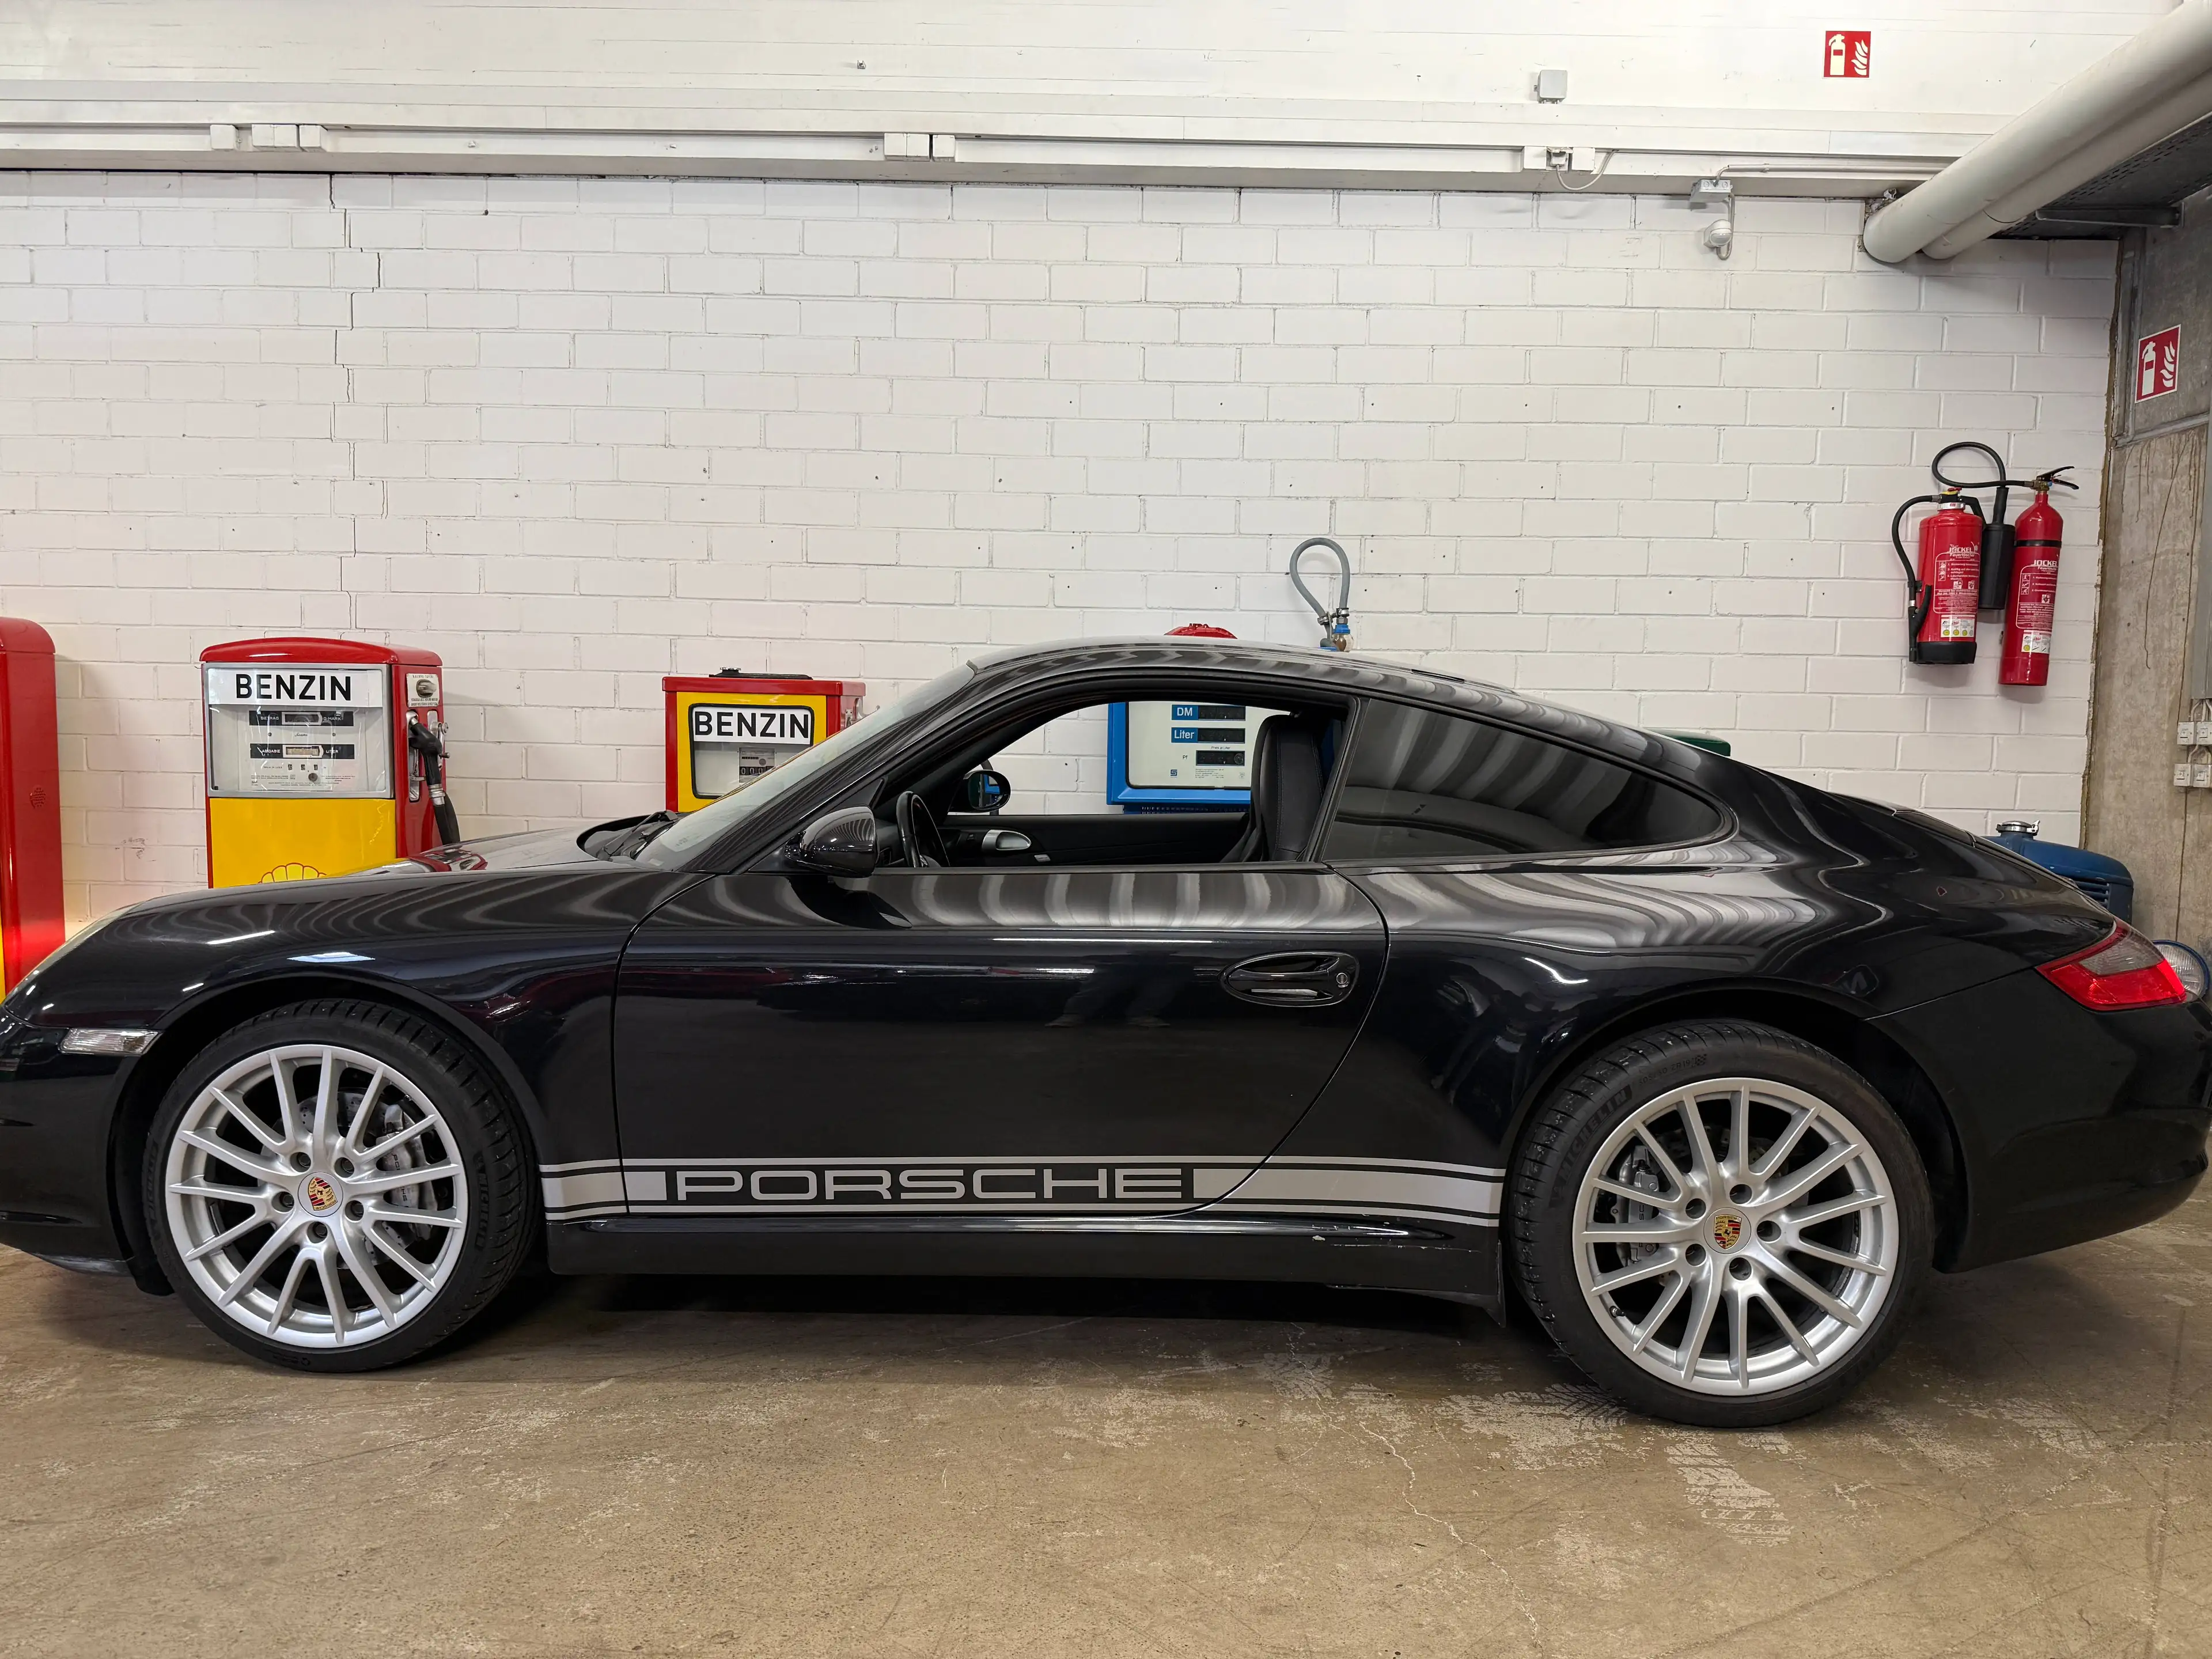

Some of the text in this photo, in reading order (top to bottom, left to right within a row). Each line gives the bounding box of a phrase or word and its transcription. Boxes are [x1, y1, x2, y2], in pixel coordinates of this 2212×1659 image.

[236, 673, 351, 702] BENZIN
[694, 711, 809, 738] BENZIN
[1177, 707, 1193, 717] DM
[1174, 729, 1195, 739] Liter
[1558, 1089, 1628, 1183] MICHELIN
[676, 1168, 1181, 1200] PORSCHE
